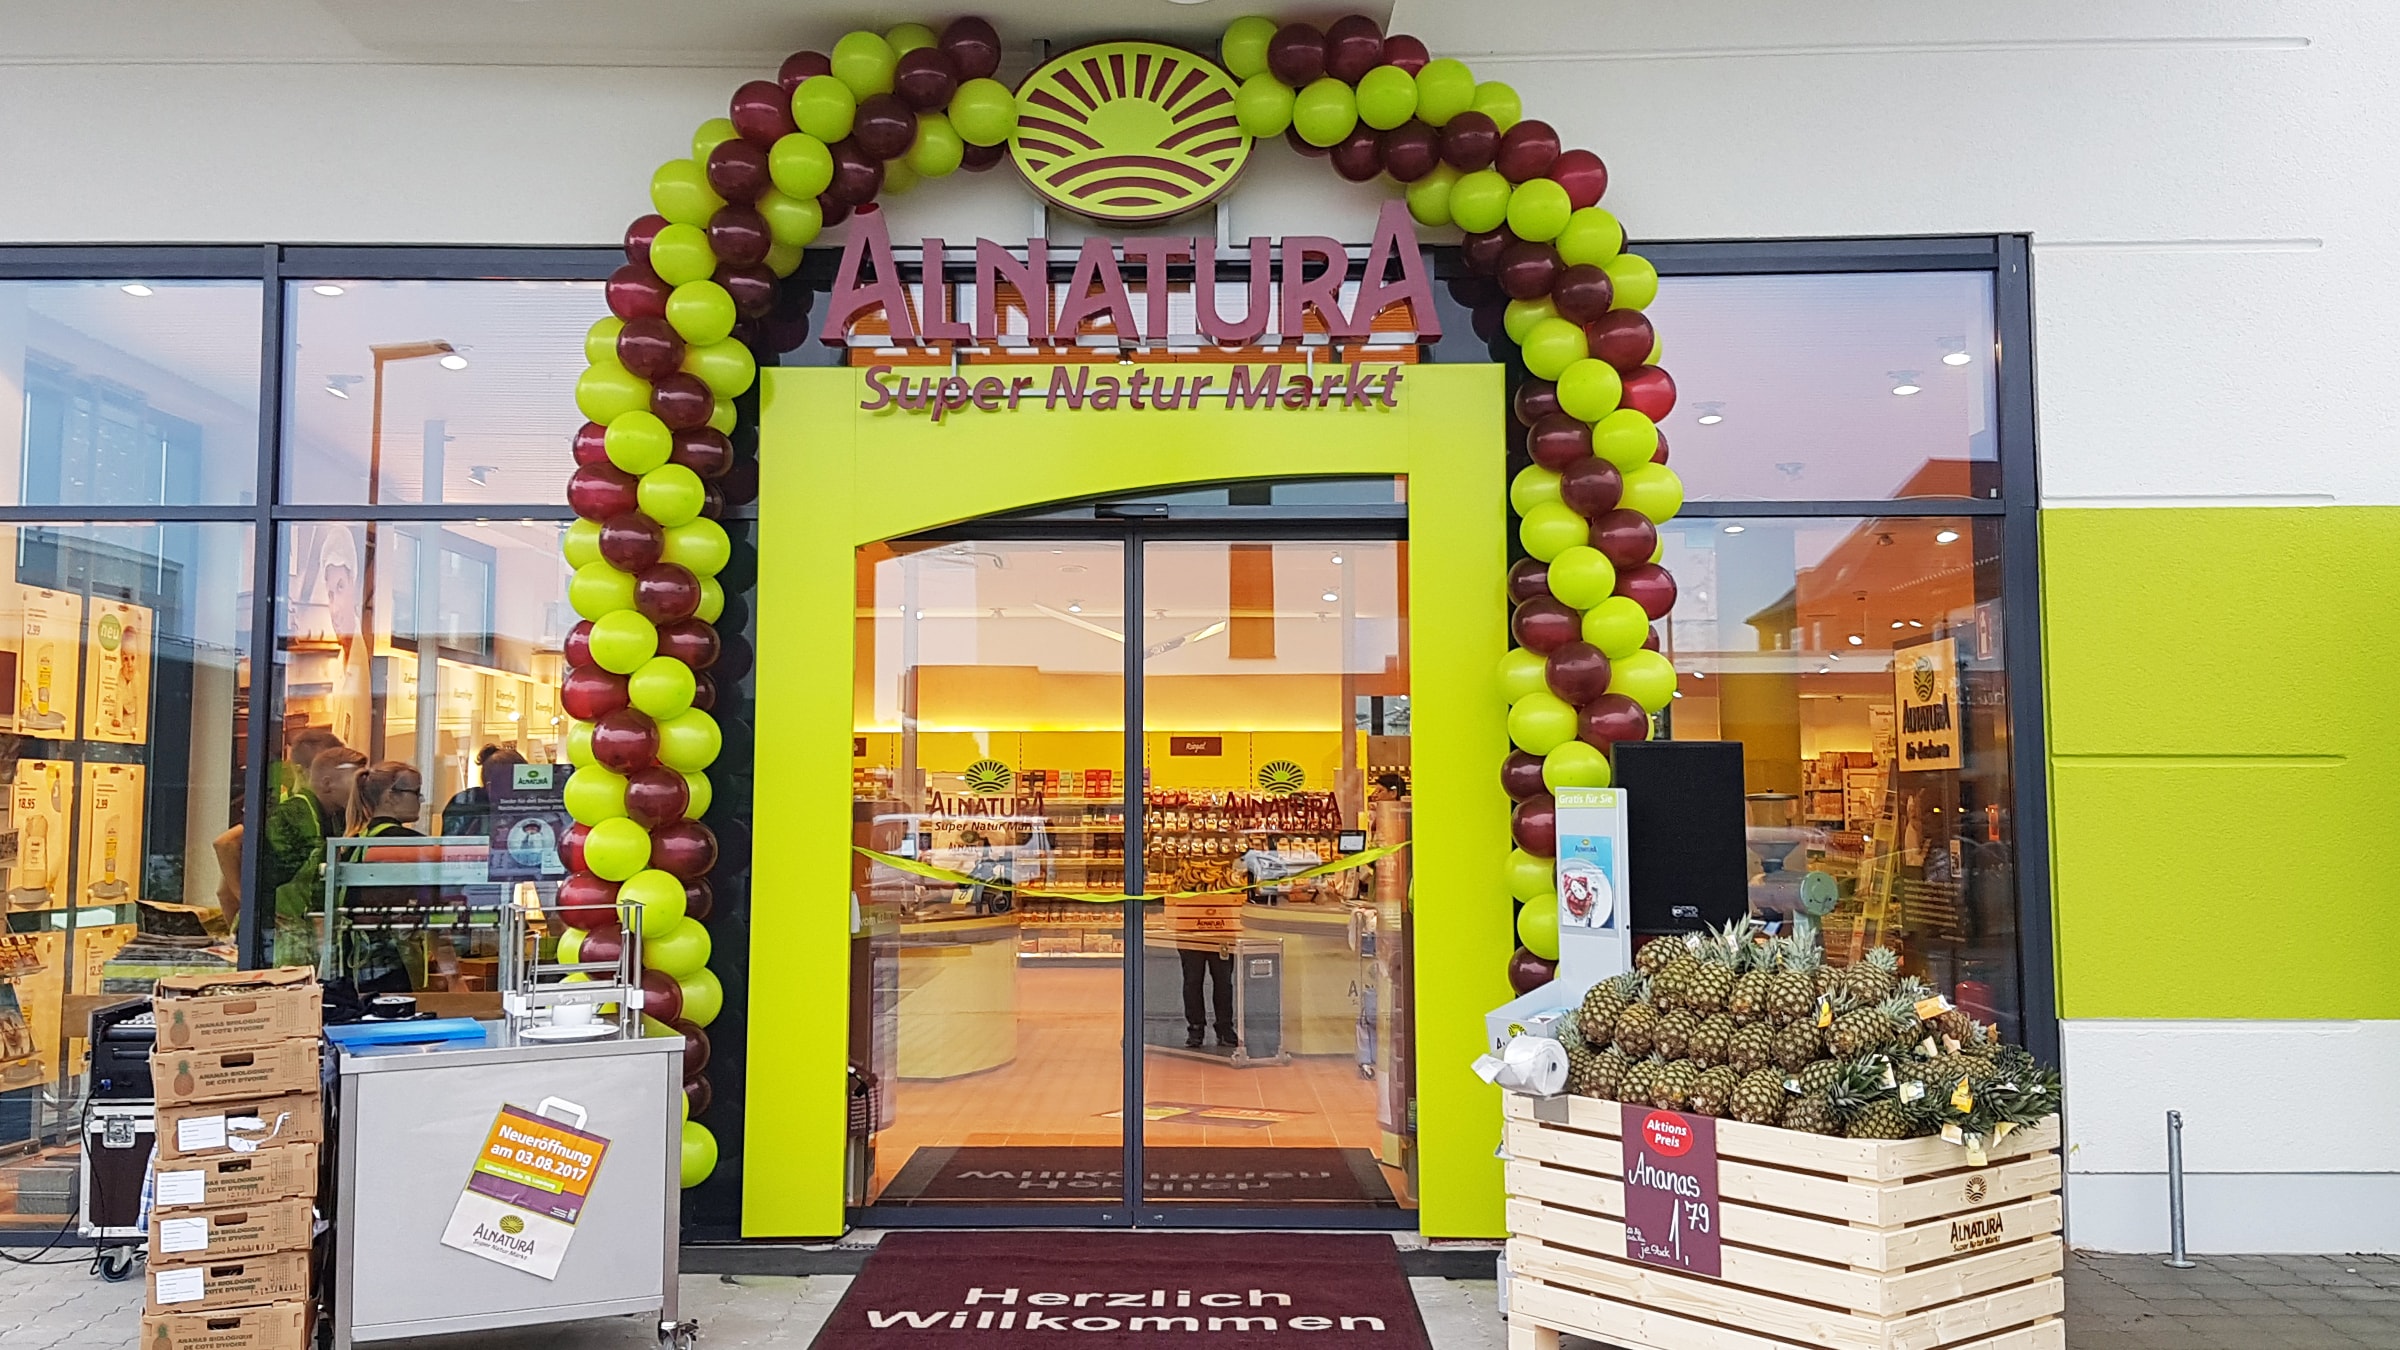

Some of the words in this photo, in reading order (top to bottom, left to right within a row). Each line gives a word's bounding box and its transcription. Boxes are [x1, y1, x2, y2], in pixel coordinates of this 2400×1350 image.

[819, 201, 1443, 347] ALNATURA
[860, 363, 1033, 423] Super
[1045, 365, 1227, 411] Natur
[1228, 361, 1404, 409] Markt
[101, 624, 119, 641] neu
[1558, 794, 1584, 805] Gratis
[1585, 793, 1598, 805] für
[1599, 793, 1614, 804] Sie
[935, 821, 968, 833] Super
[971, 821, 1004, 831] Natur
[1646, 1119, 1687, 1136] Aktions
[1654, 1132, 1680, 1148] Preis
[498, 1124, 593, 1166] Neueröffnung
[490, 1143, 513, 1159] am
[515, 1149, 588, 1182] 03.08.2017
[1628, 1151, 1700, 1198] Ananas
[472, 1222, 535, 1256] ALNATURA
[1950, 1211, 2004, 1244] ALNATURA
[963, 1286, 1294, 1308] Herzlich
[866, 1309, 1387, 1334] Willkommen
